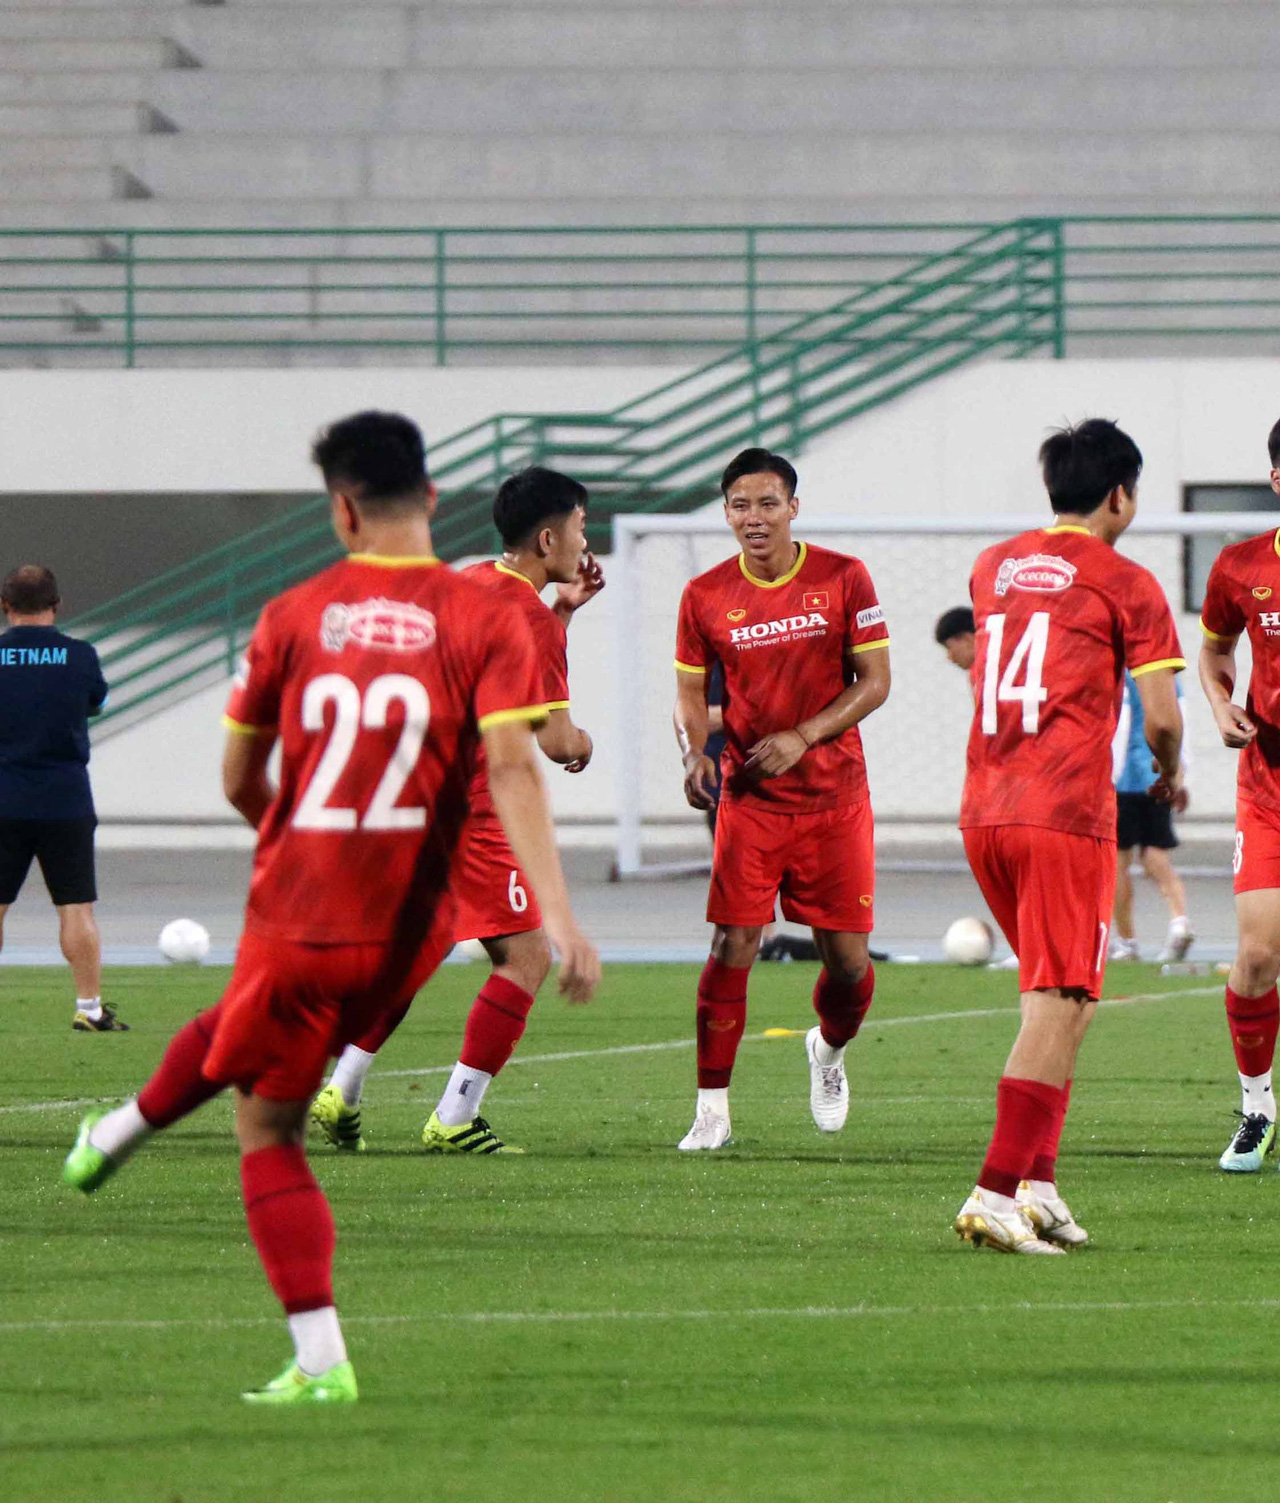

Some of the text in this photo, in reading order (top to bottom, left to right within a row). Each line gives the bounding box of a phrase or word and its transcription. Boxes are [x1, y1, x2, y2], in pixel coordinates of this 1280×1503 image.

[730, 613, 829, 643] HONDA
[735, 628, 826, 651] The Power of Dreams
[1265, 628, 1280, 636] The
[982, 611, 1050, 735] 14
[291, 673, 431, 831] 22
[509, 870, 528, 912] 6
